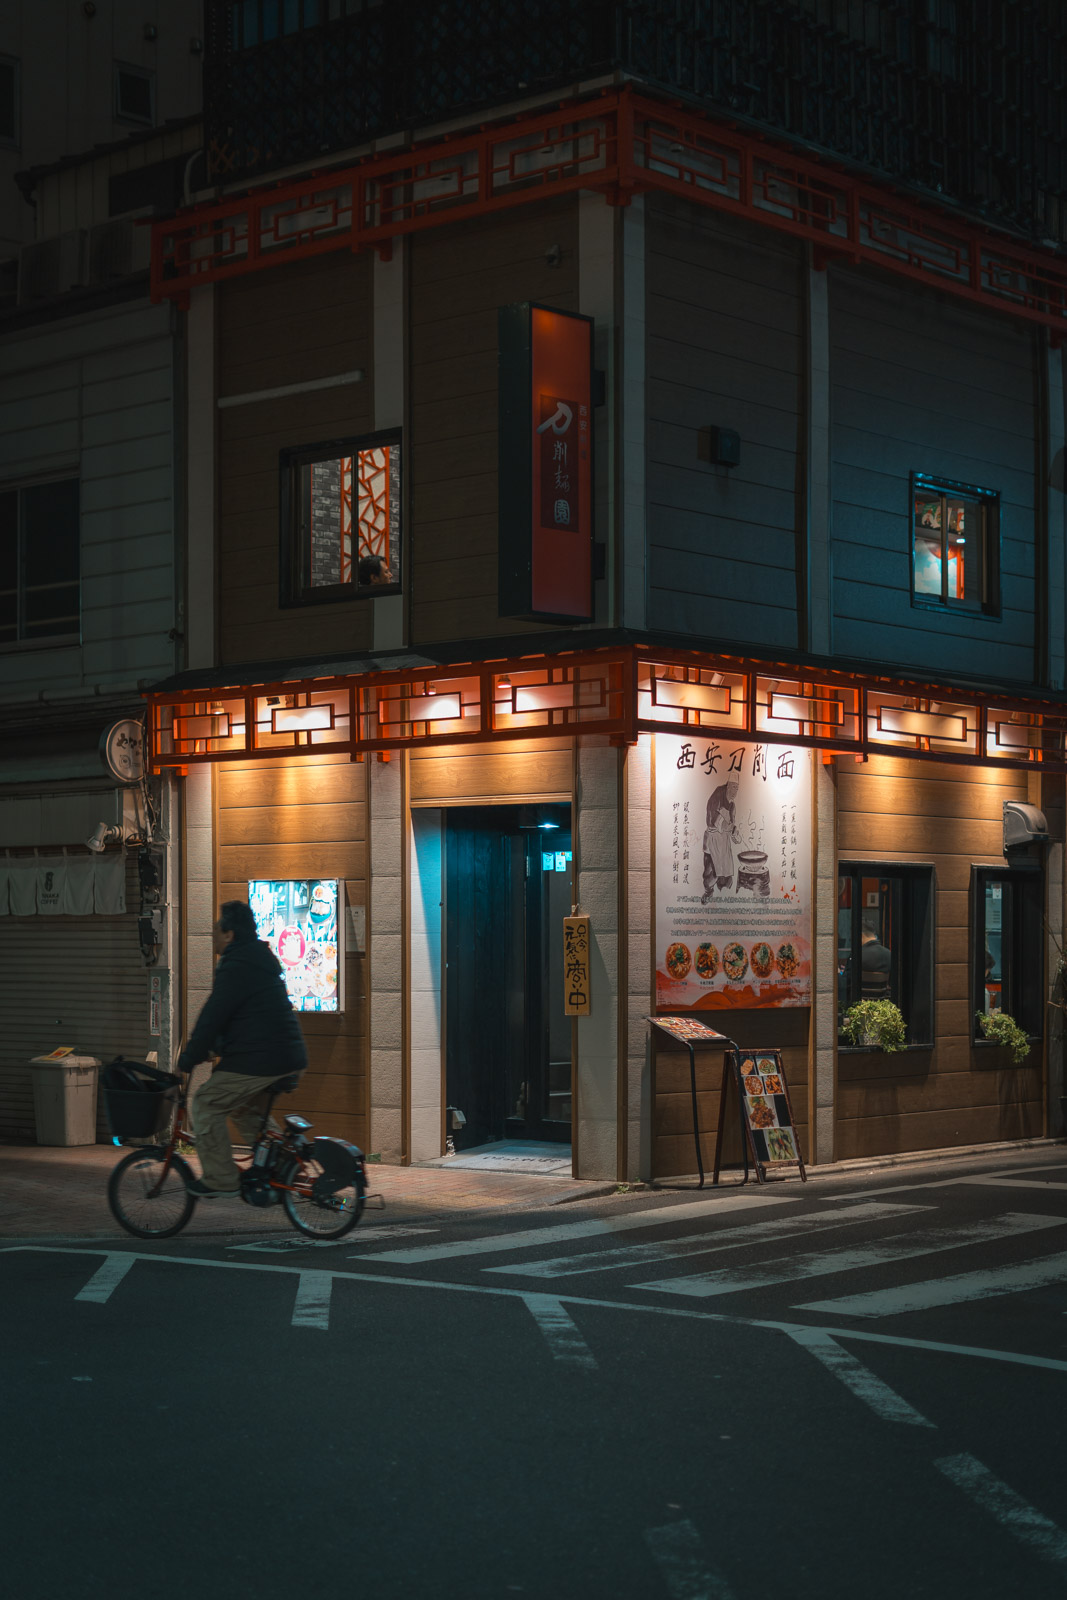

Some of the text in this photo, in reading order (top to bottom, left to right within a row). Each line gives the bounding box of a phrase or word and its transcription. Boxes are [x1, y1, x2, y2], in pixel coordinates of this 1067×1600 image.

[677, 742, 795, 781] 西安刀削面
[566, 959, 587, 1010] 商い中
